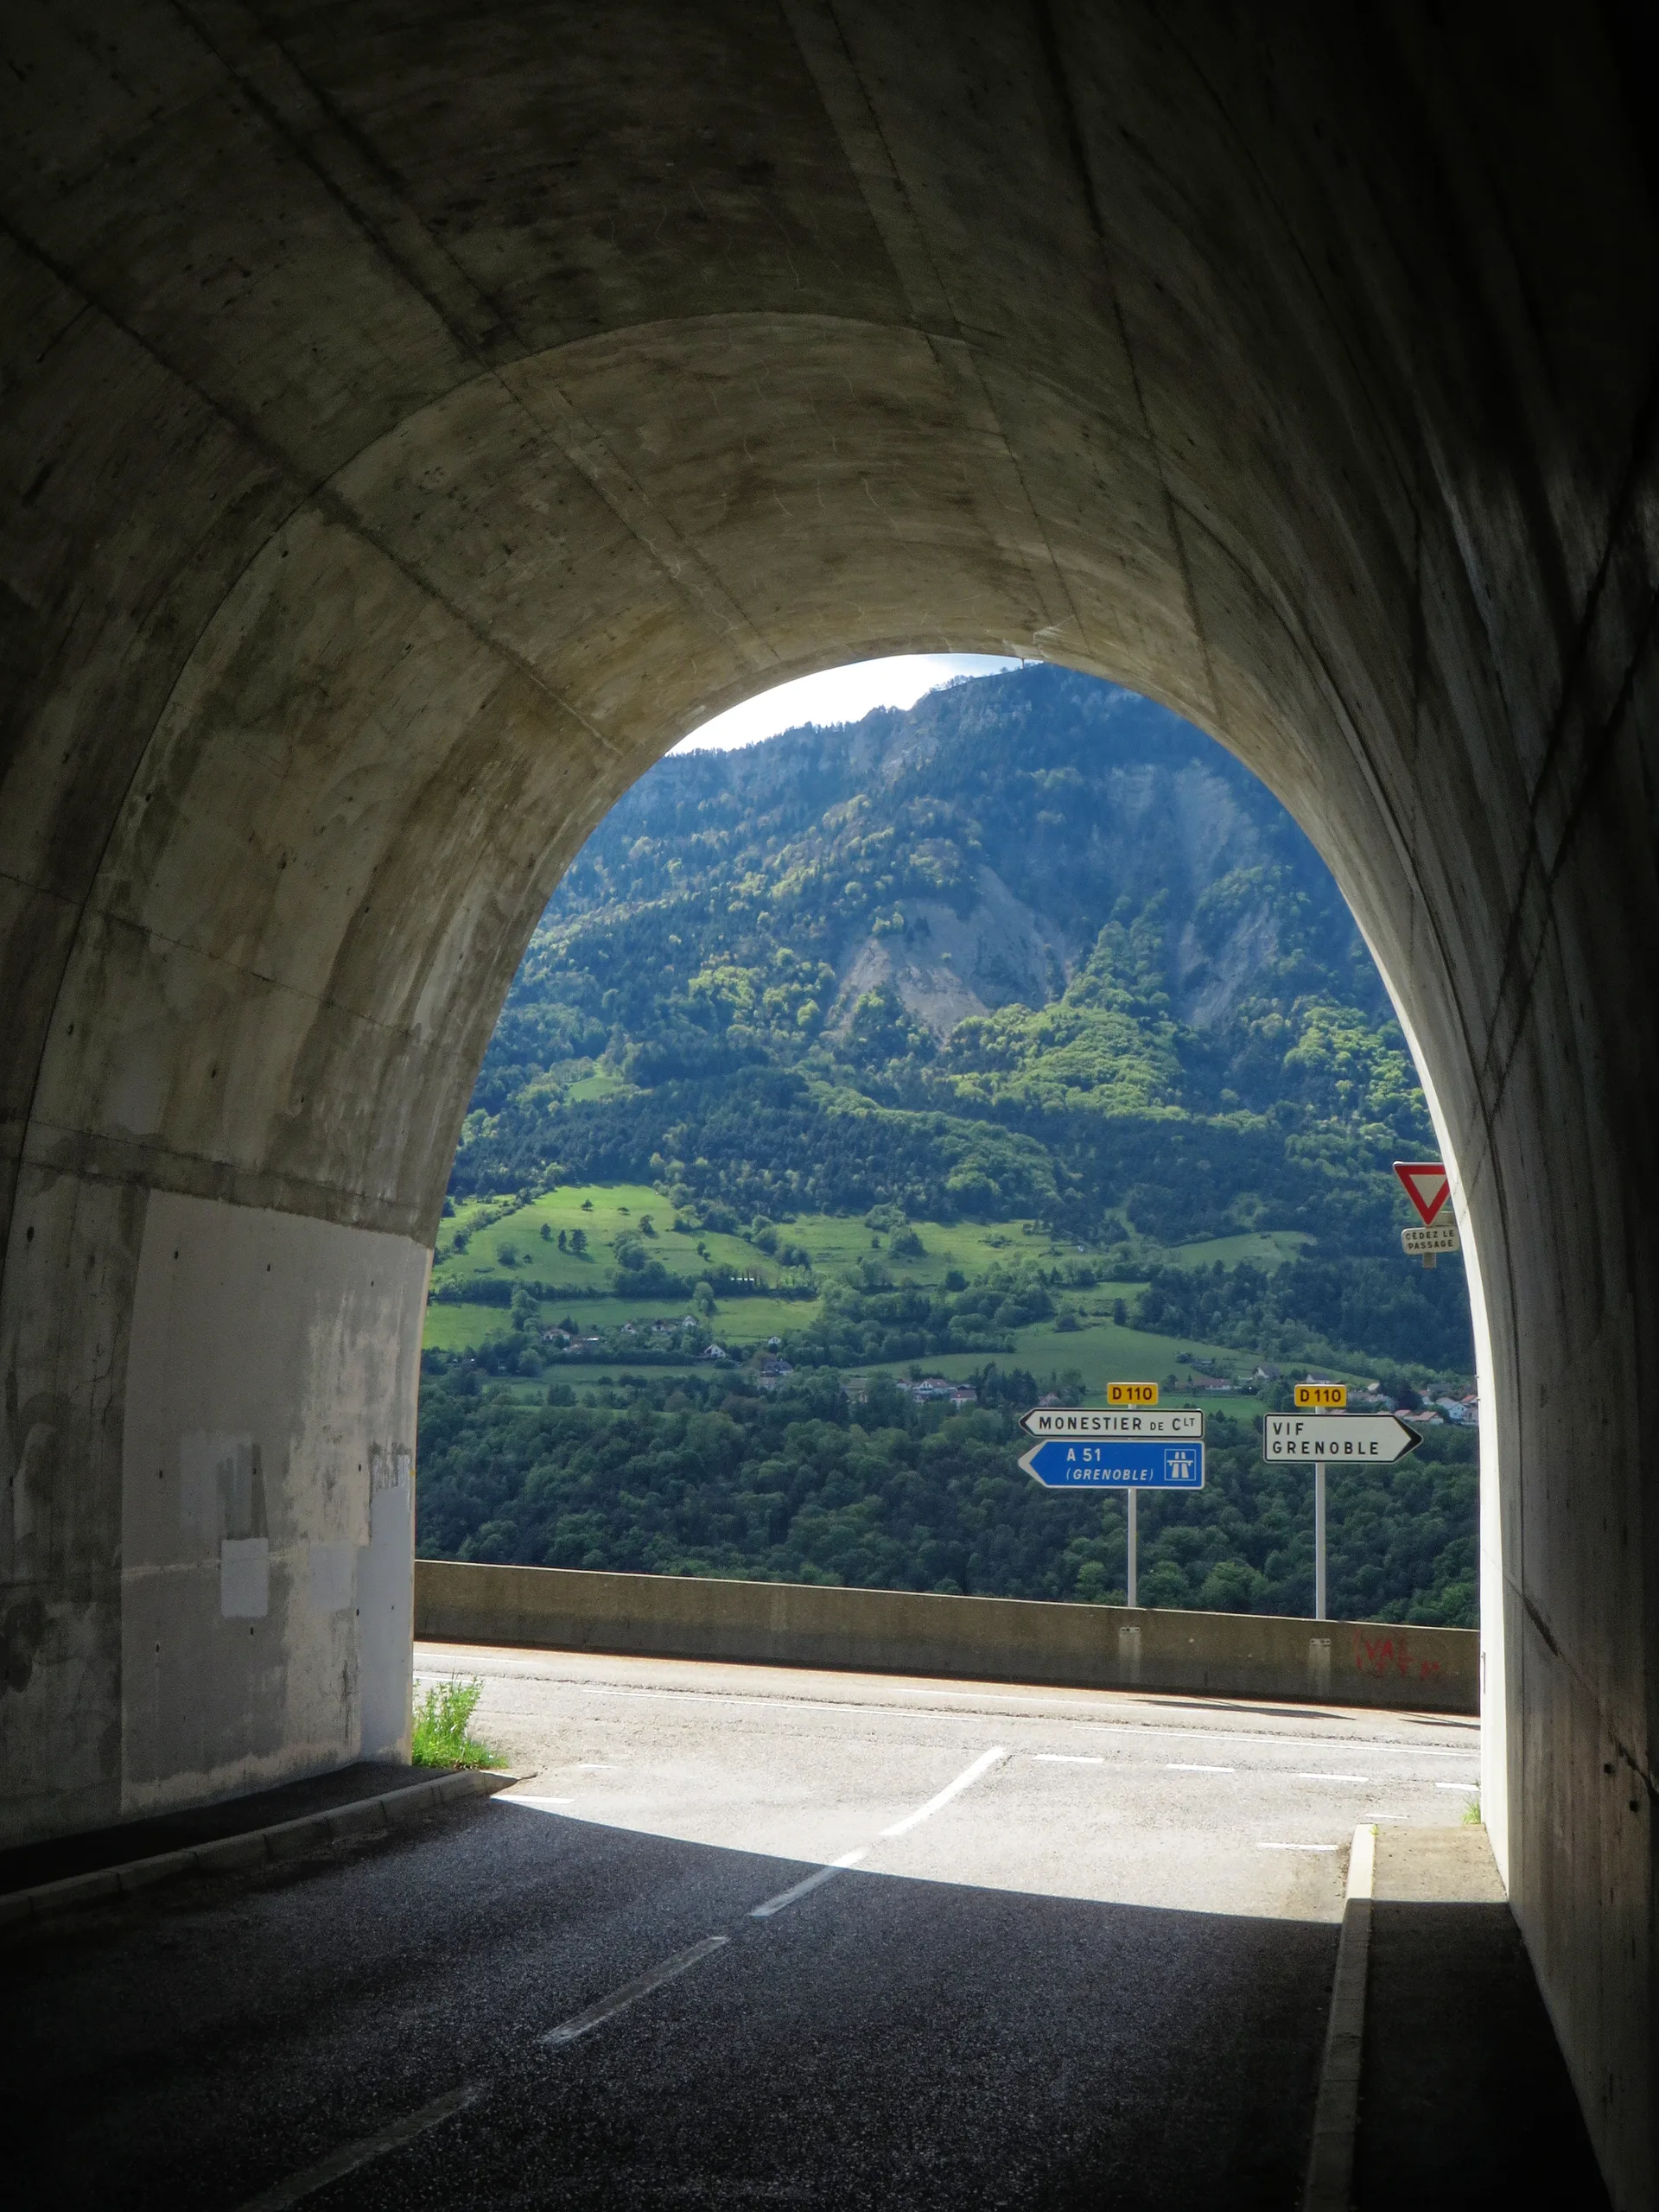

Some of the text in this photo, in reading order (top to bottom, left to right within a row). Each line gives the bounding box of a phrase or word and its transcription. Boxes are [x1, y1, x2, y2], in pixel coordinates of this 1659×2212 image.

[1405, 1230, 1439, 1240] CÉDEZ
[1408, 1239, 1453, 1249] PASSAGE
[1112, 1387, 1153, 1400] D 110
[1300, 1389, 1341, 1402] D 110
[1039, 1416, 1141, 1430] MONESTIER
[1150, 1421, 1164, 1431] DE
[1273, 1422, 1304, 1435] VIF
[1273, 1441, 1379, 1454] GRENOBLE
[1066, 1448, 1101, 1462] A 51
[1065, 1468, 1154, 1481] (GRENOBLE)
